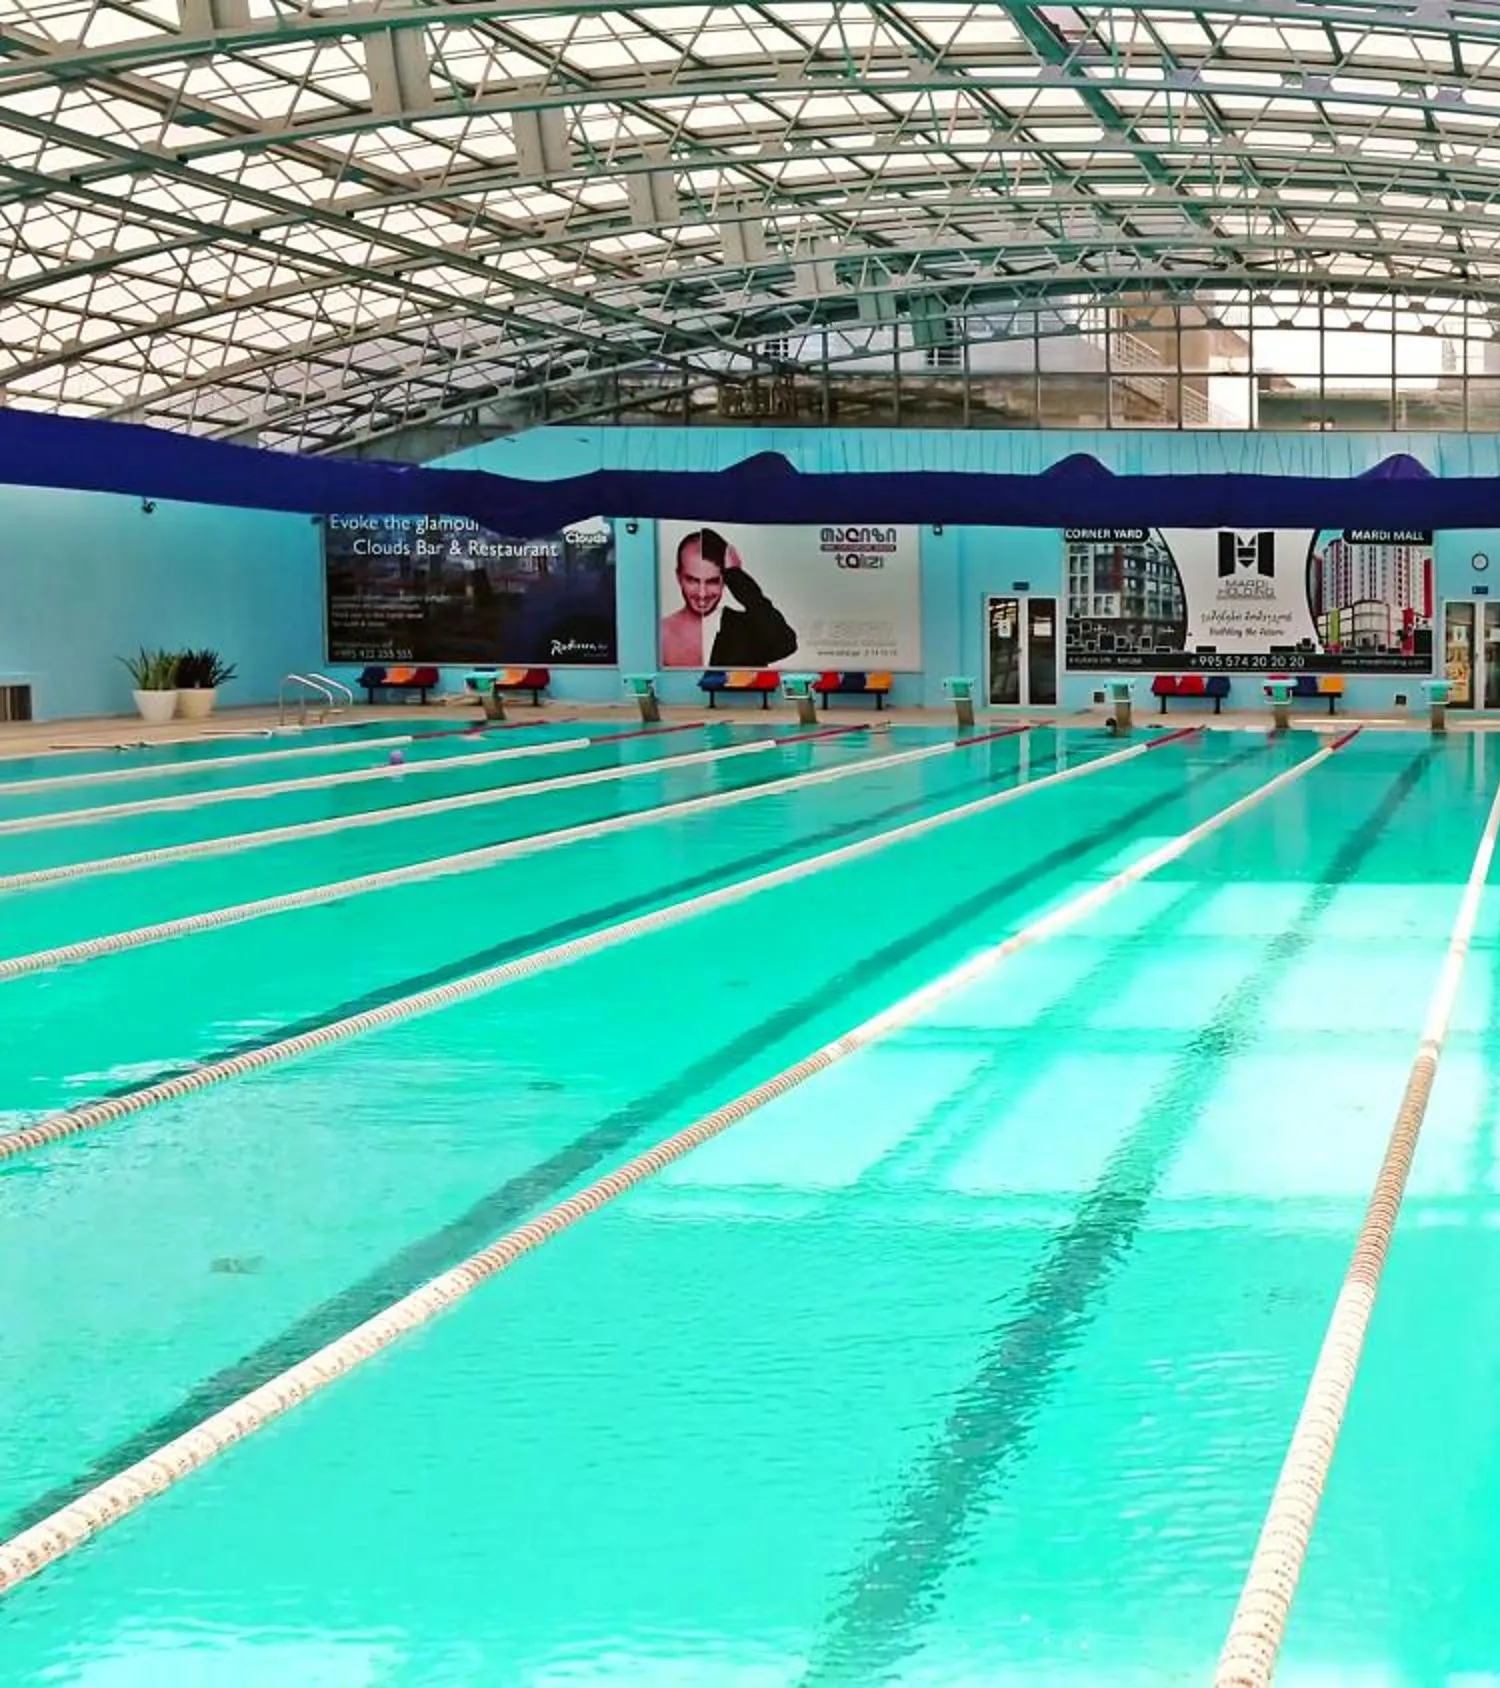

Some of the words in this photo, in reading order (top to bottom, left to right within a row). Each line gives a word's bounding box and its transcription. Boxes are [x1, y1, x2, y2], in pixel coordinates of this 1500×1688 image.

[330, 513, 380, 530] Evoke
[383, 513, 411, 531] the
[565, 532, 608, 544] Clouds
[1065, 527, 1111, 539] CORNER
[1113, 527, 1144, 539] YARD
[1351, 529, 1391, 541] MARDI
[1393, 530, 1425, 542] MALL
[353, 538, 411, 556] Clouds
[415, 538, 444, 556] Bar
[449, 539, 461, 556] &
[468, 539, 559, 557] Restaurant
[1251, 655, 1267, 667] 20
[1270, 655, 1287, 667] 20
[1289, 656, 1305, 668] 20
